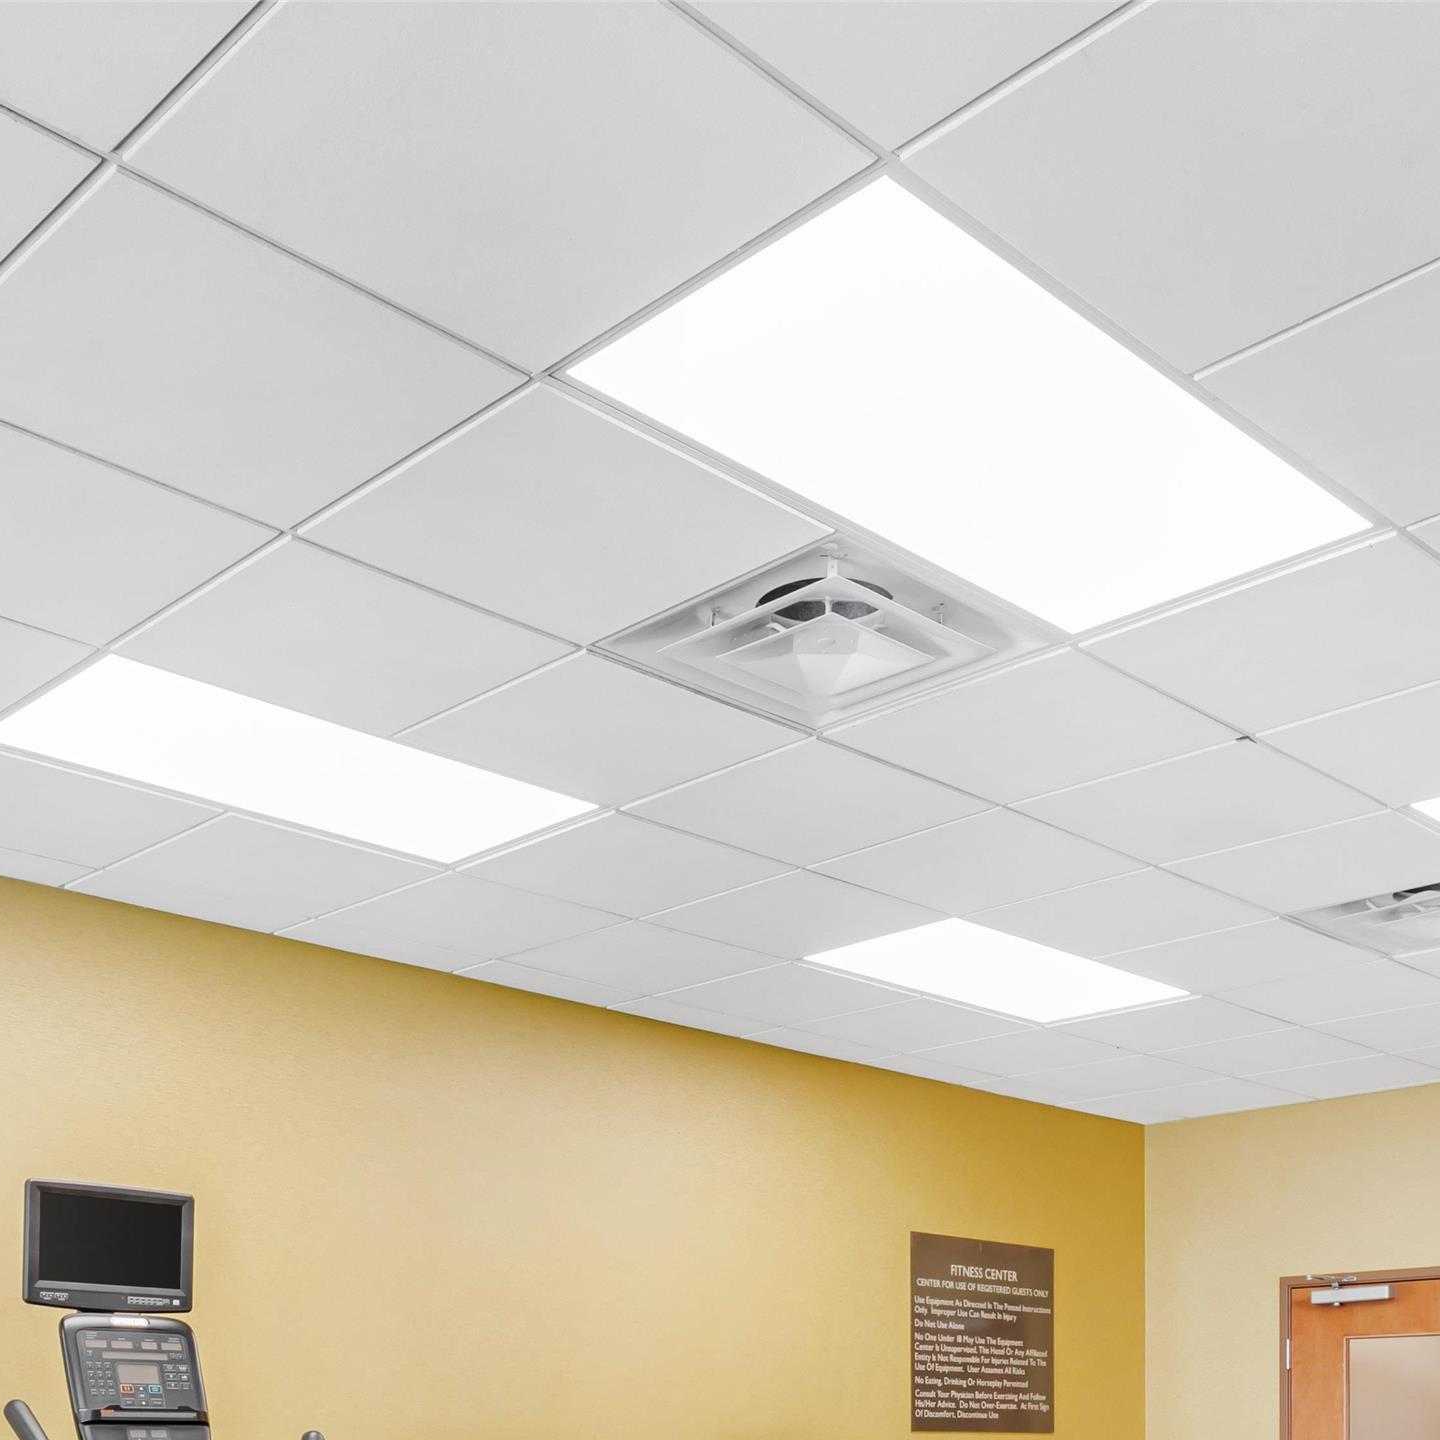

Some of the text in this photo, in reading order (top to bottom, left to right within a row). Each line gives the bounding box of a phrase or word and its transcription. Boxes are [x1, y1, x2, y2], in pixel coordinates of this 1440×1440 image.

[950, 1264, 1018, 1282] FITNESS CENTER
[916, 1278, 941, 1288] CENTER
[942, 1280, 954, 1288] FOR
[977, 1284, 1011, 1294] REGISTERED
[1012, 1287, 1032, 1296] GUESTS
[1033, 1289, 1048, 1298] ONLY
[914, 1296, 925, 1304] Use
[993, 1302, 1003, 1310] The
[957, 1309, 967, 1317] Use
[924, 1320, 936, 1328] Not
[948, 1321, 964, 1330] Alone
[914, 1332, 924, 1340] No
[925, 1333, 936, 1341] One
[938, 1334, 955, 1342] Under
[963, 1336, 974, 1345] May
[975, 1336, 985, 1344] Use
[1015, 1349, 1025, 1357] Any
[915, 1363, 925, 1371] Use
[1013, 1367, 1025, 1375] Risks
[944, 1377, 966, 1387] Drinking
[951, 1391, 974, 1400] Physician
